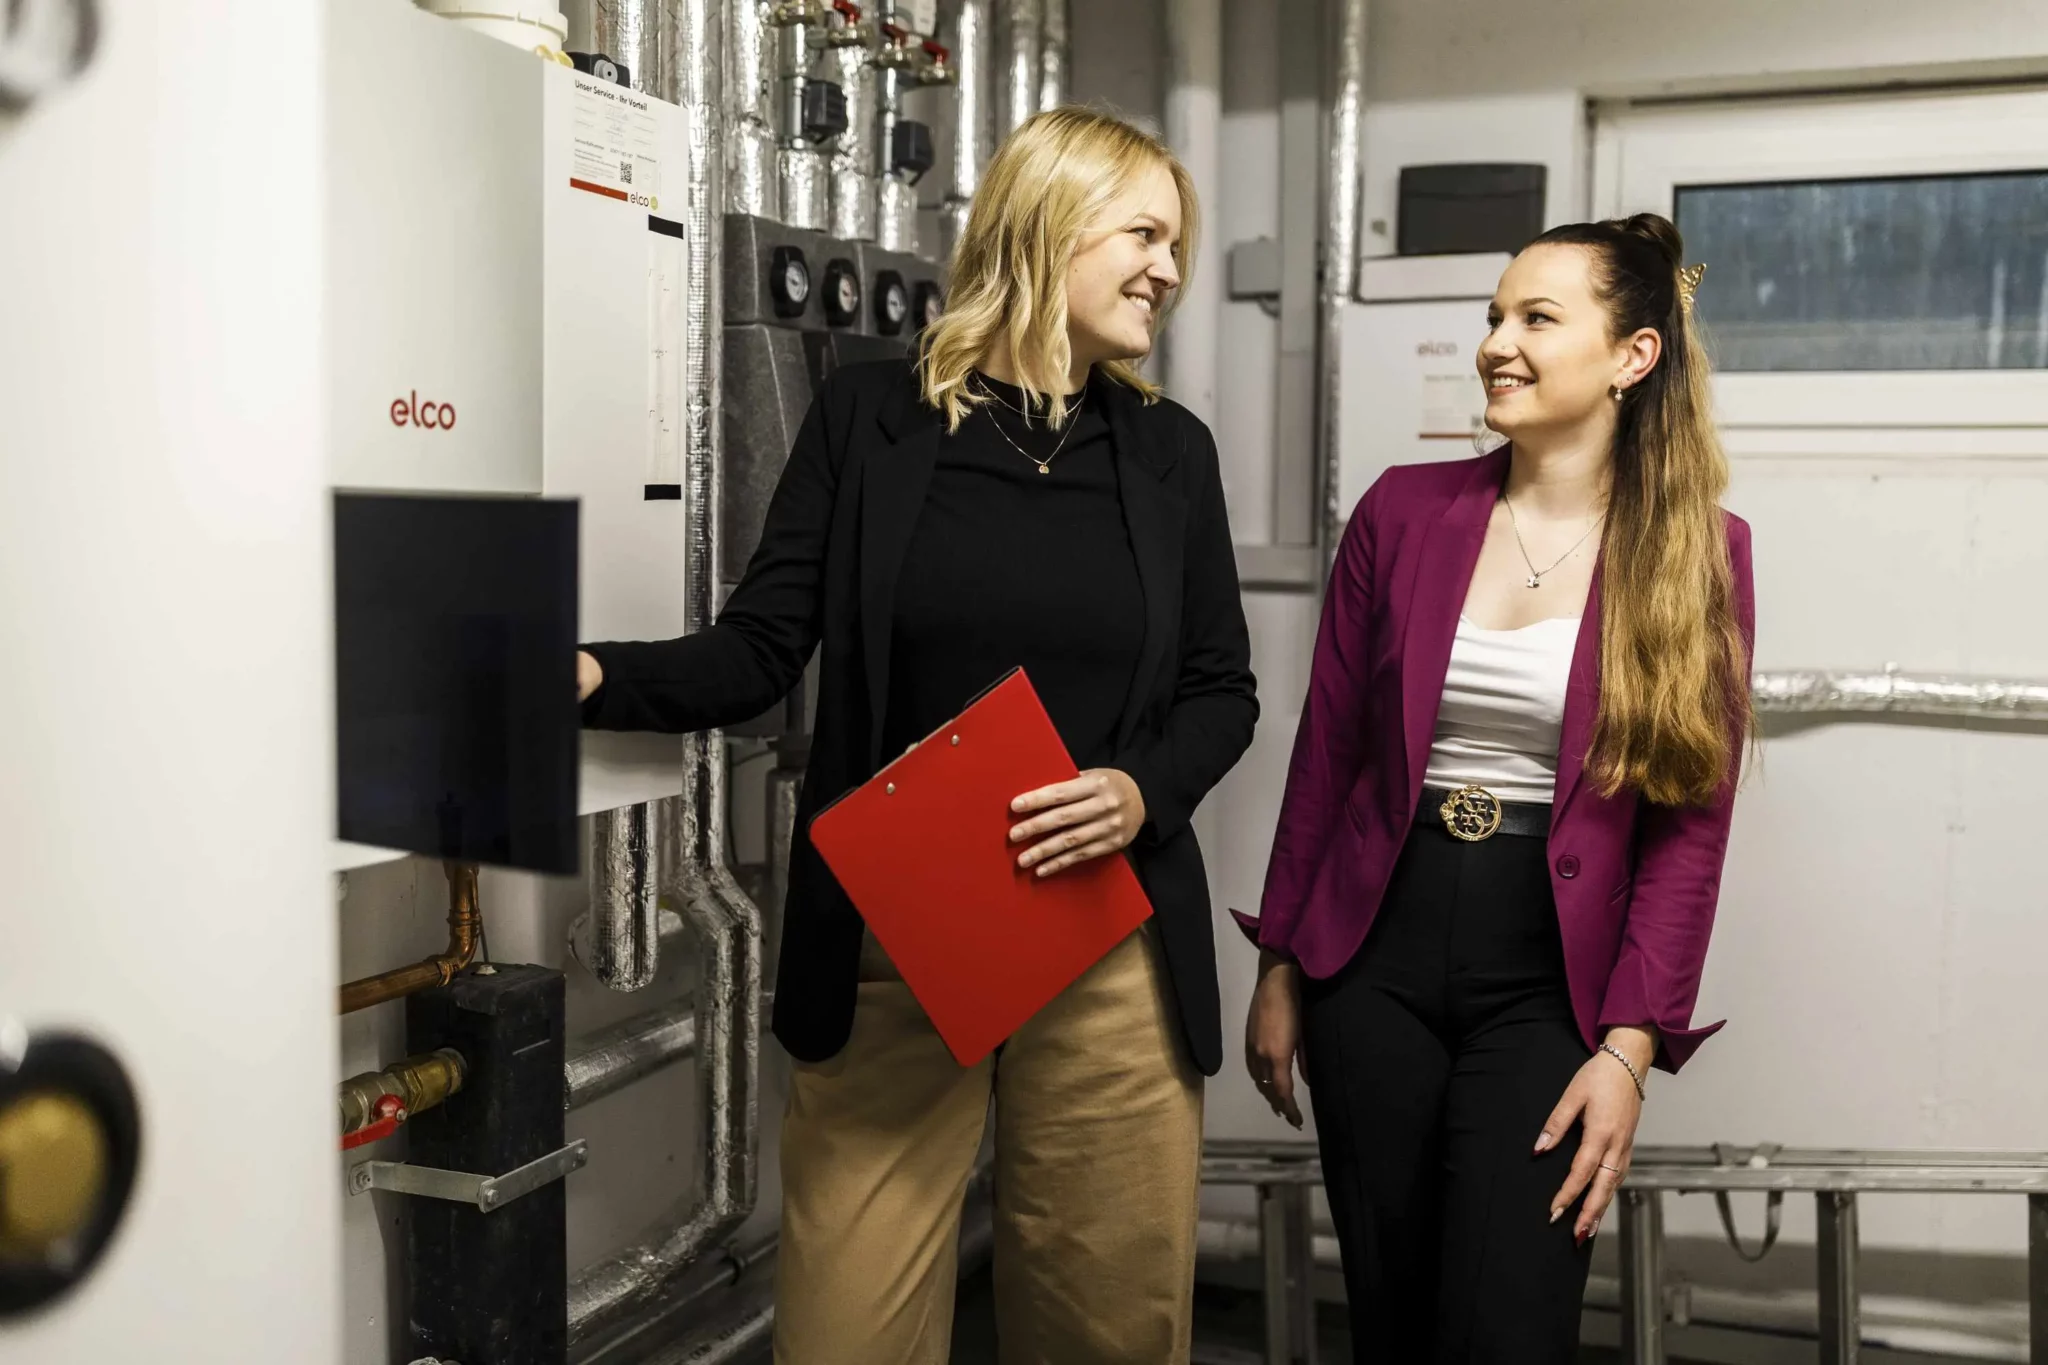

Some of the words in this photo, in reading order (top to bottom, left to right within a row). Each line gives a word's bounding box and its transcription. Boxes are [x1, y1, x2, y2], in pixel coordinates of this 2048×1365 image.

[575, 79, 592, 92] Unser
[593, 85, 615, 100] Service
[619, 94, 628, 104] Ihr
[628, 98, 648, 111] Vorteil
[630, 192, 649, 207] elco
[1417, 341, 1458, 356] elco
[391, 389, 456, 430] elco
